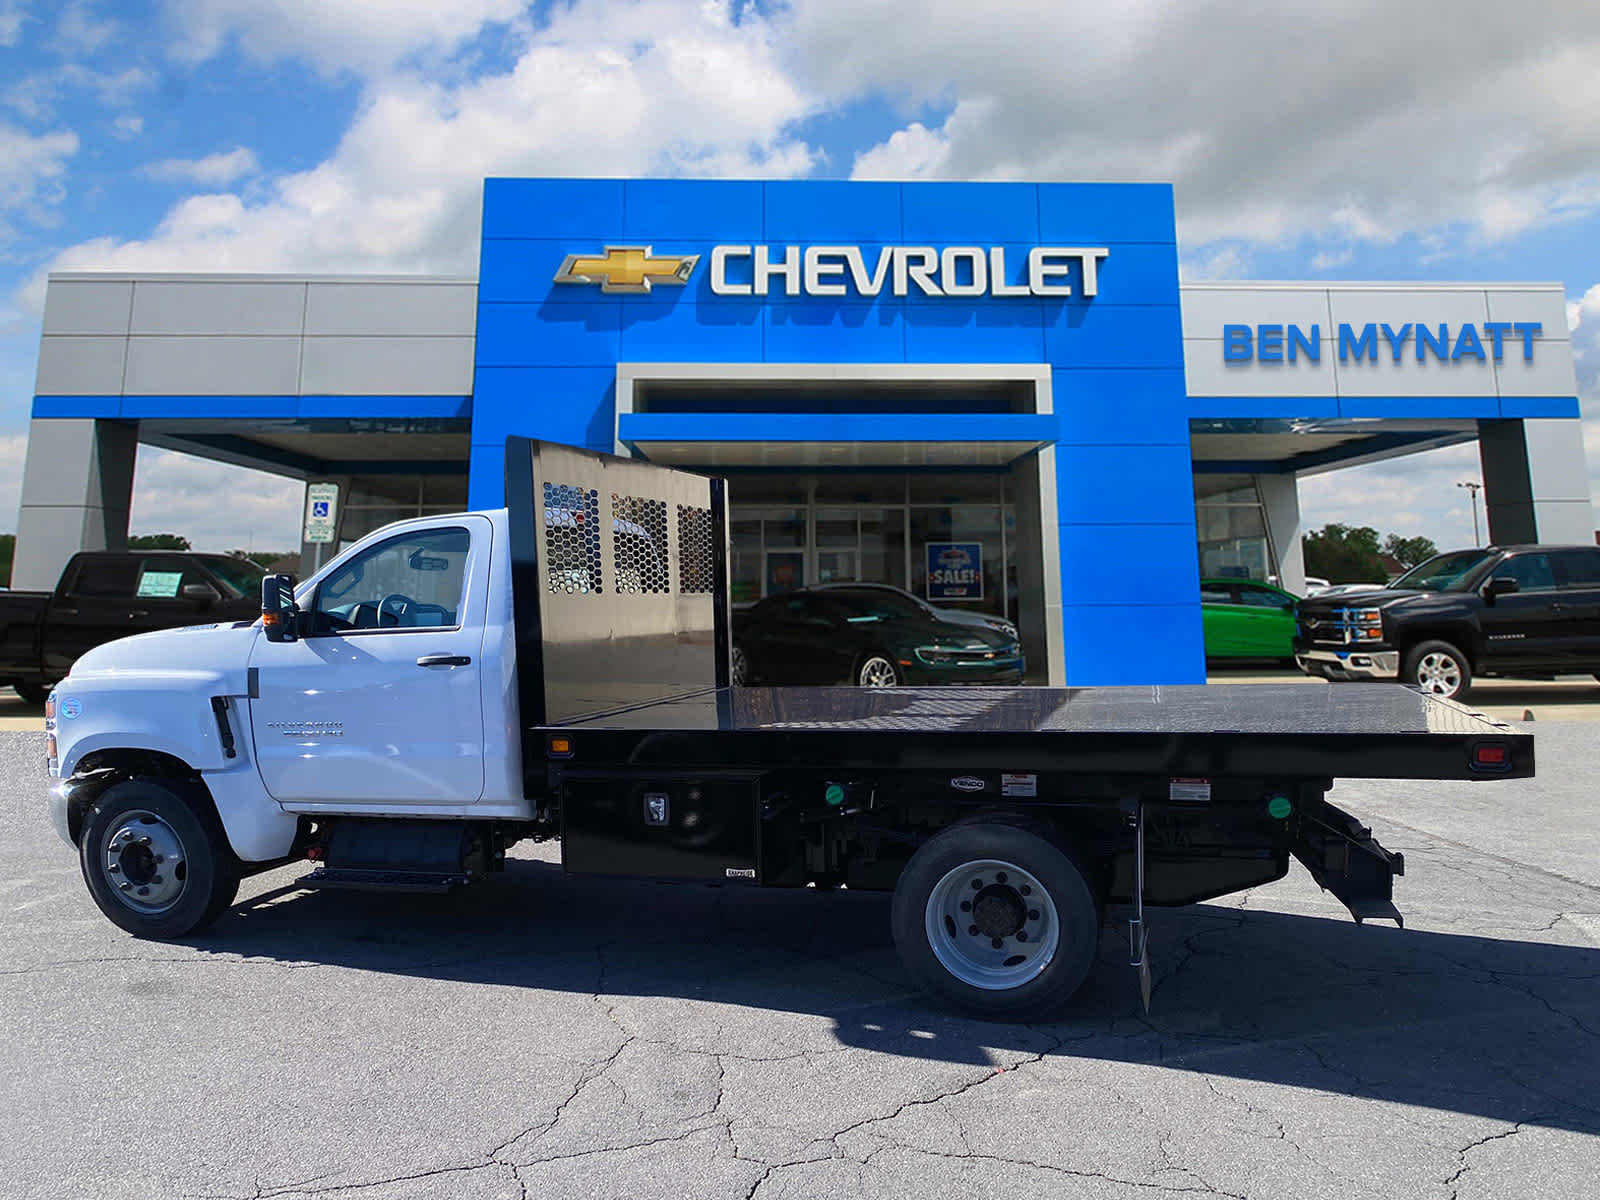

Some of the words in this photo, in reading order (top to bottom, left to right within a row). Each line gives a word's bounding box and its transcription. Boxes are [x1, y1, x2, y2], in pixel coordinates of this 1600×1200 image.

[710, 245, 1110, 297] CHEVROLET
[1223, 323, 1321, 364] BEN
[1338, 321, 1543, 364] MYNATT
[934, 569, 976, 584] SALE!
